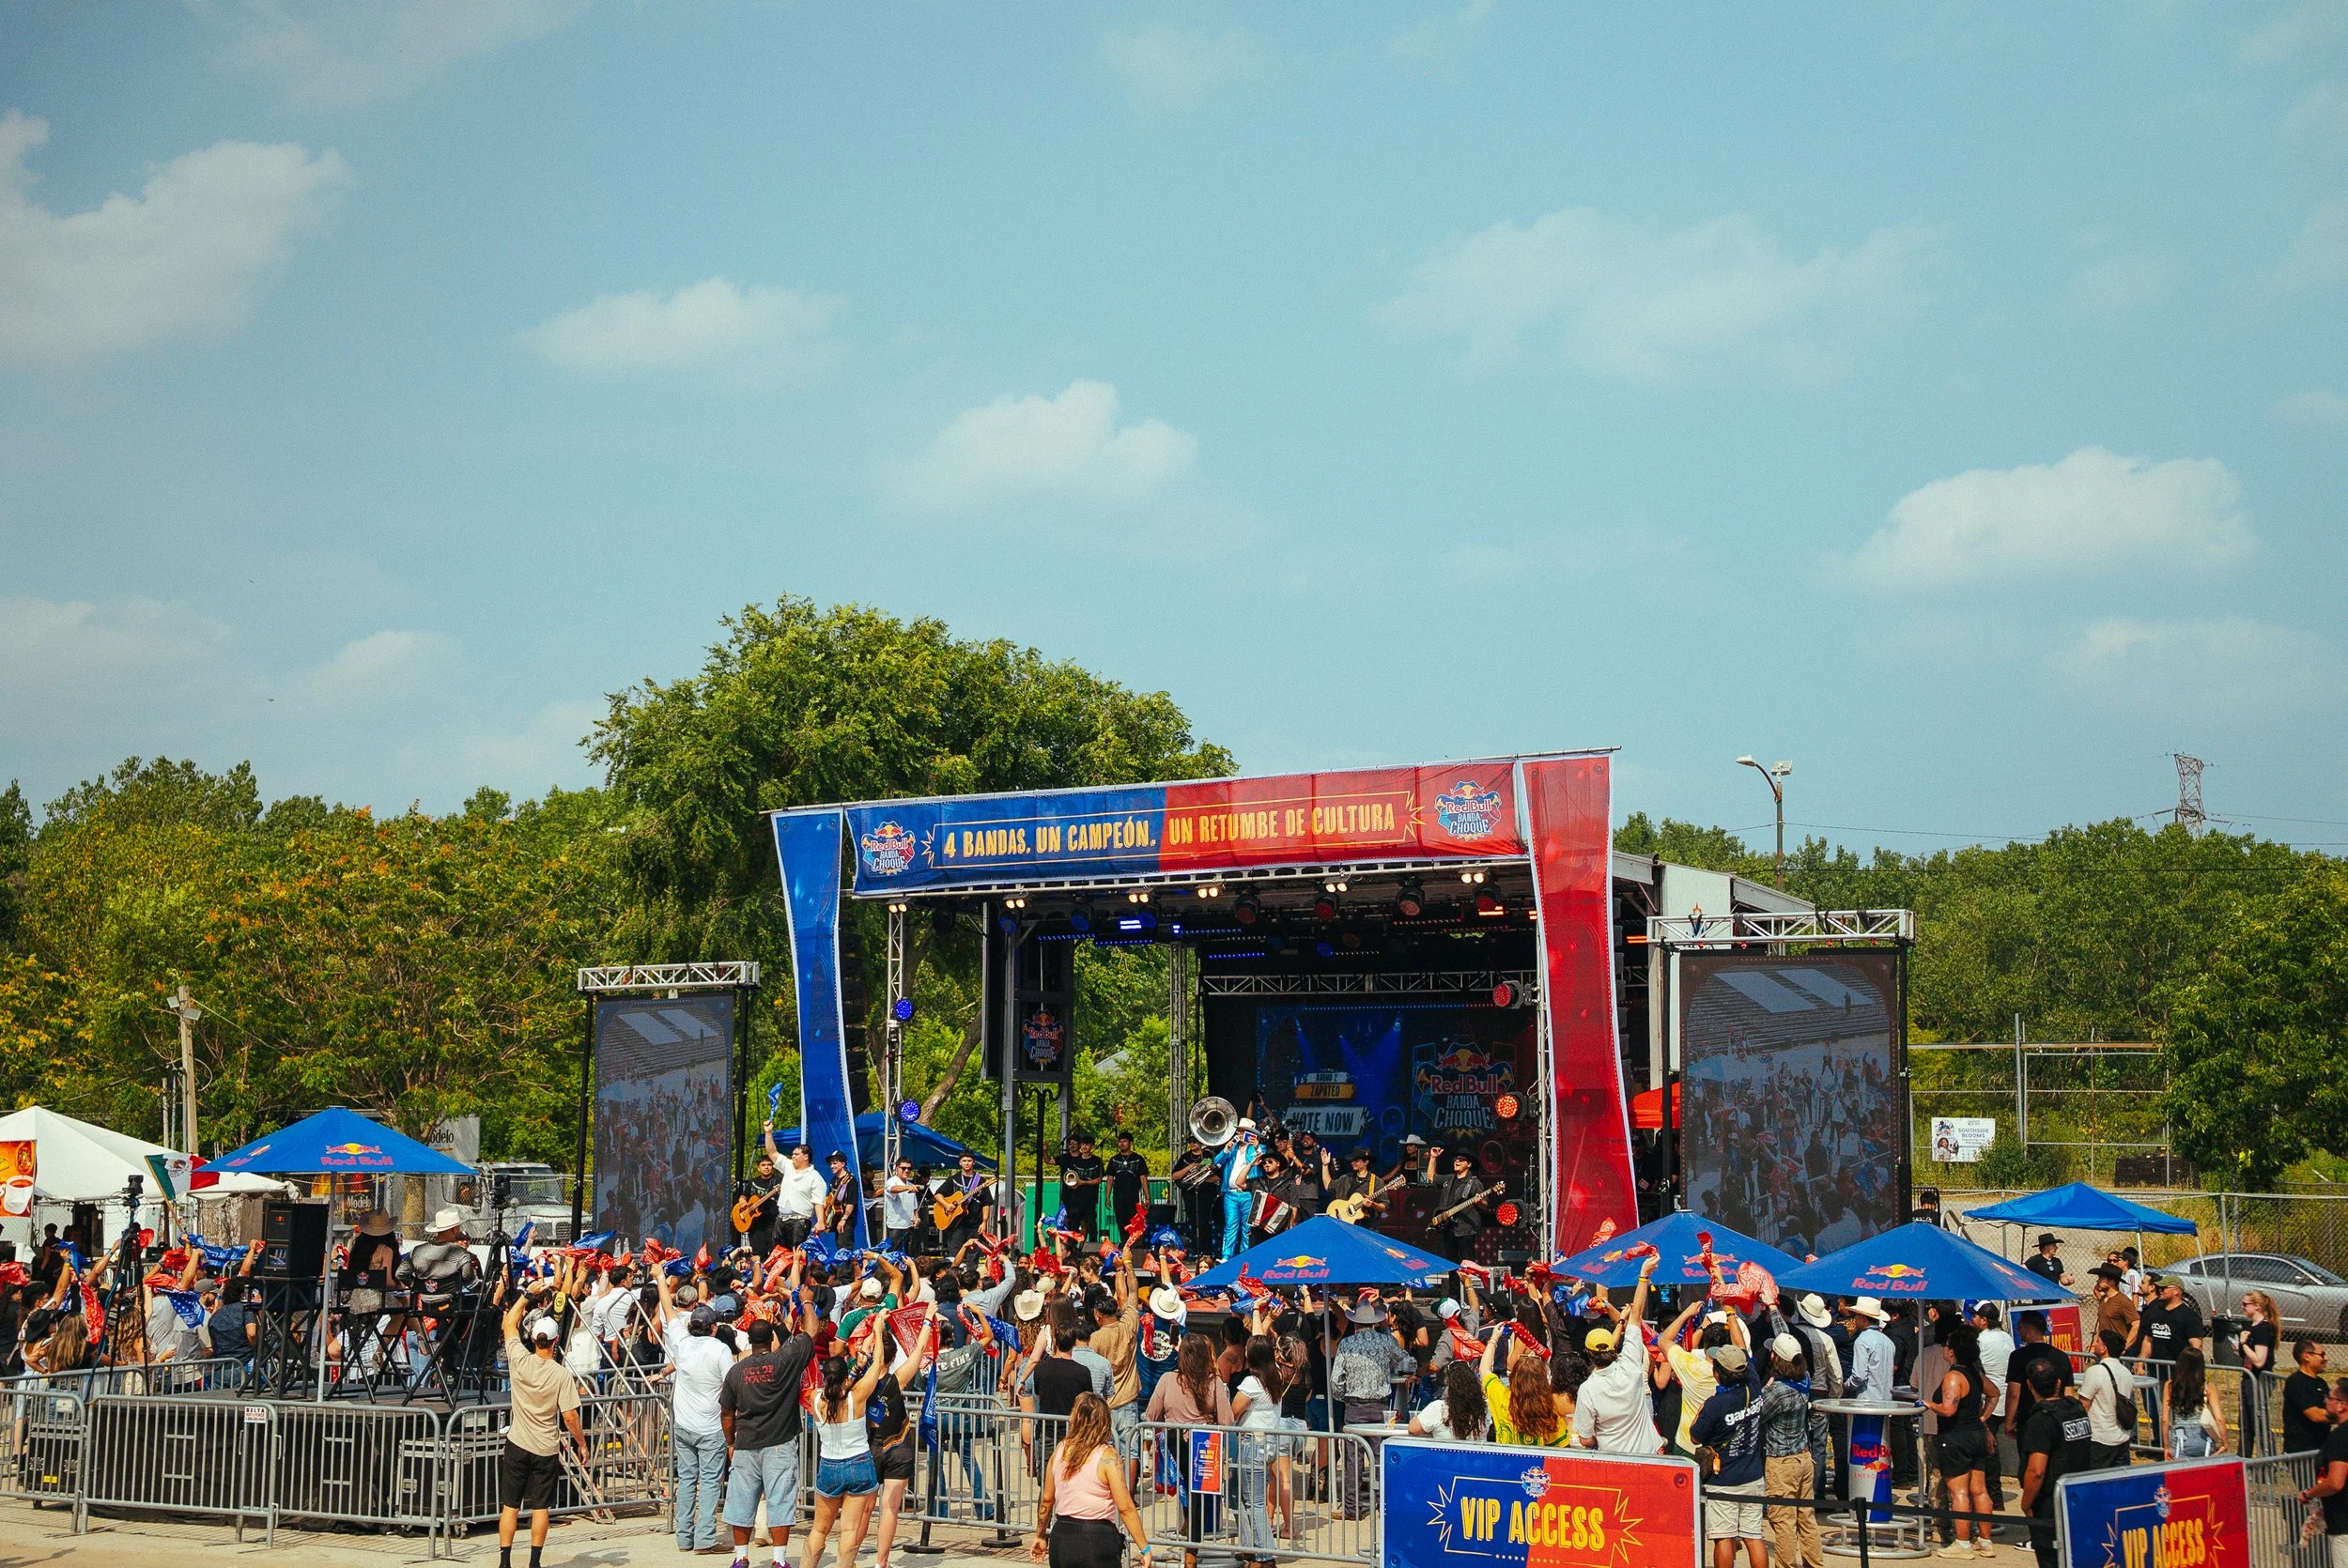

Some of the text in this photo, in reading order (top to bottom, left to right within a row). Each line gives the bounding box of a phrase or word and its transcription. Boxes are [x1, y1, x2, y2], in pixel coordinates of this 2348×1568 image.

[1446, 799, 1492, 813] Red Bull
[1168, 803, 1396, 845] UN RETUMBE DE CULTURA
[1458, 812, 1481, 822] BANDA
[1449, 819, 1491, 835] CHOQUE
[871, 837, 908, 852] Red Bull
[944, 816, 1156, 858] 4 BANDAS. UN CAMPEÓN.
[880, 850, 900, 859] BANDA
[873, 856, 907, 870] CHOQUE
[1029, 1026, 1058, 1039] Red Bull
[1430, 1074, 1498, 1094] Red Bull
[1446, 1095, 1480, 1109] BANDA
[1292, 1112, 1354, 1133] VOTE NOW
[1434, 1106, 1494, 1130] CHOQUE
[430, 1129, 455, 1144] odelo
[320, 1156, 394, 1165] Red Bull
[1262, 1268, 1330, 1280] Red Bull
[1850, 1277, 1928, 1292] Red Bull
[1851, 1443, 1878, 1458] Red
[1460, 1496, 1605, 1551] VIP ACCESS
[2122, 1517, 2206, 1568] VIP ACCESS
